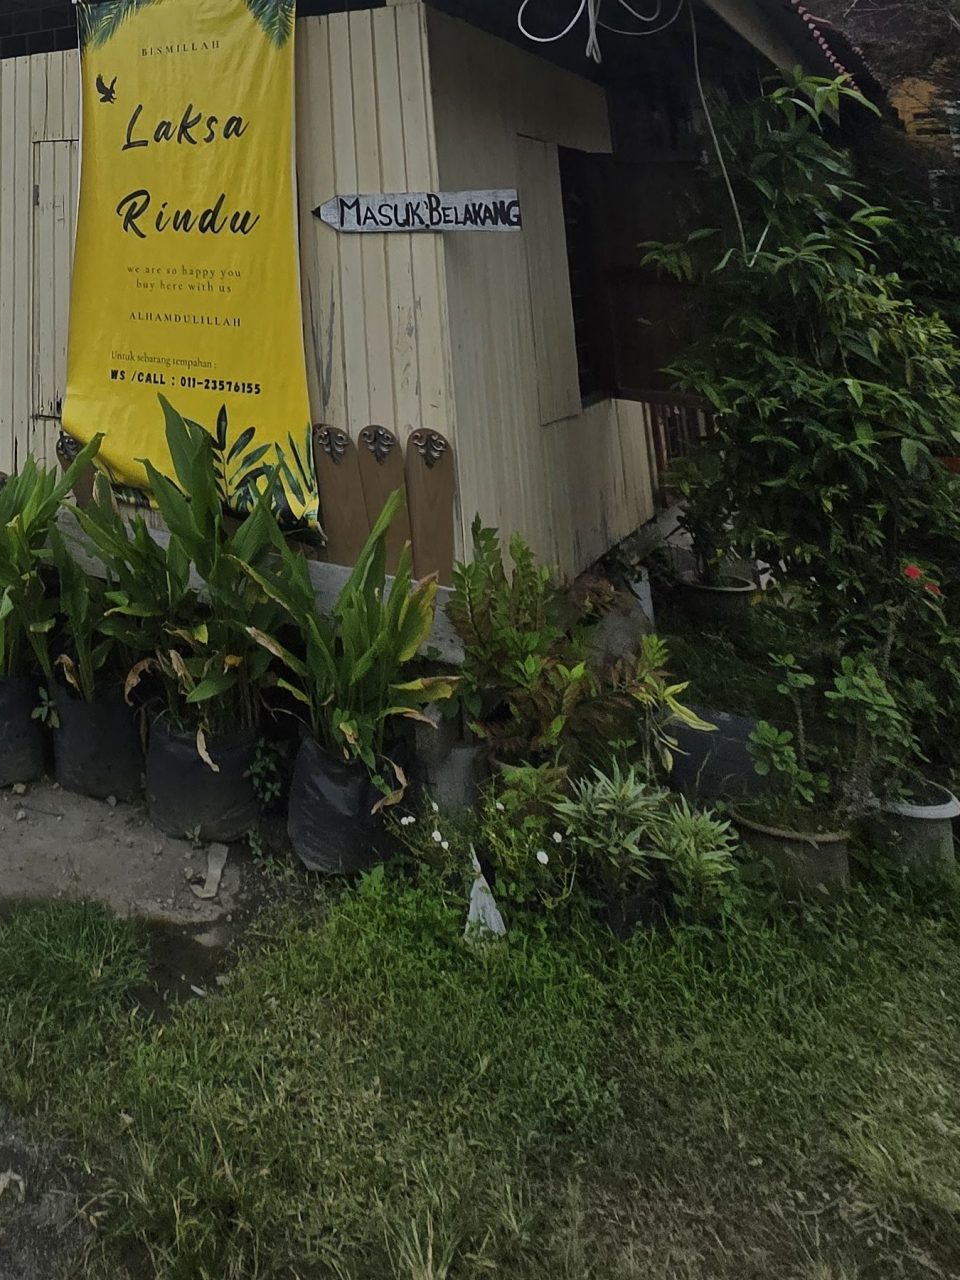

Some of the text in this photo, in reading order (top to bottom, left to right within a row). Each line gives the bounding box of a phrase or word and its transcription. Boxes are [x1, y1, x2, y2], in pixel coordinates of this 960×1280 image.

[141, 40, 219, 56] BISMILLAH
[122, 104, 249, 150] Laksa
[116, 189, 259, 238] Rindu
[426, 193, 521, 227] BELAKANG
[182, 265, 215, 278] happy
[220, 269, 241, 280] you
[136, 279, 232, 293] buy here with us
[129, 311, 241, 327] ALHAMDULILLAH
[111, 351, 136, 361] Untuk
[137, 352, 171, 368] sebarang
[172, 357, 212, 370] tempahan
[110, 369, 126, 380] WS
[131, 370, 166, 385] /CALL
[180, 376, 261, 395] 011-23576155
